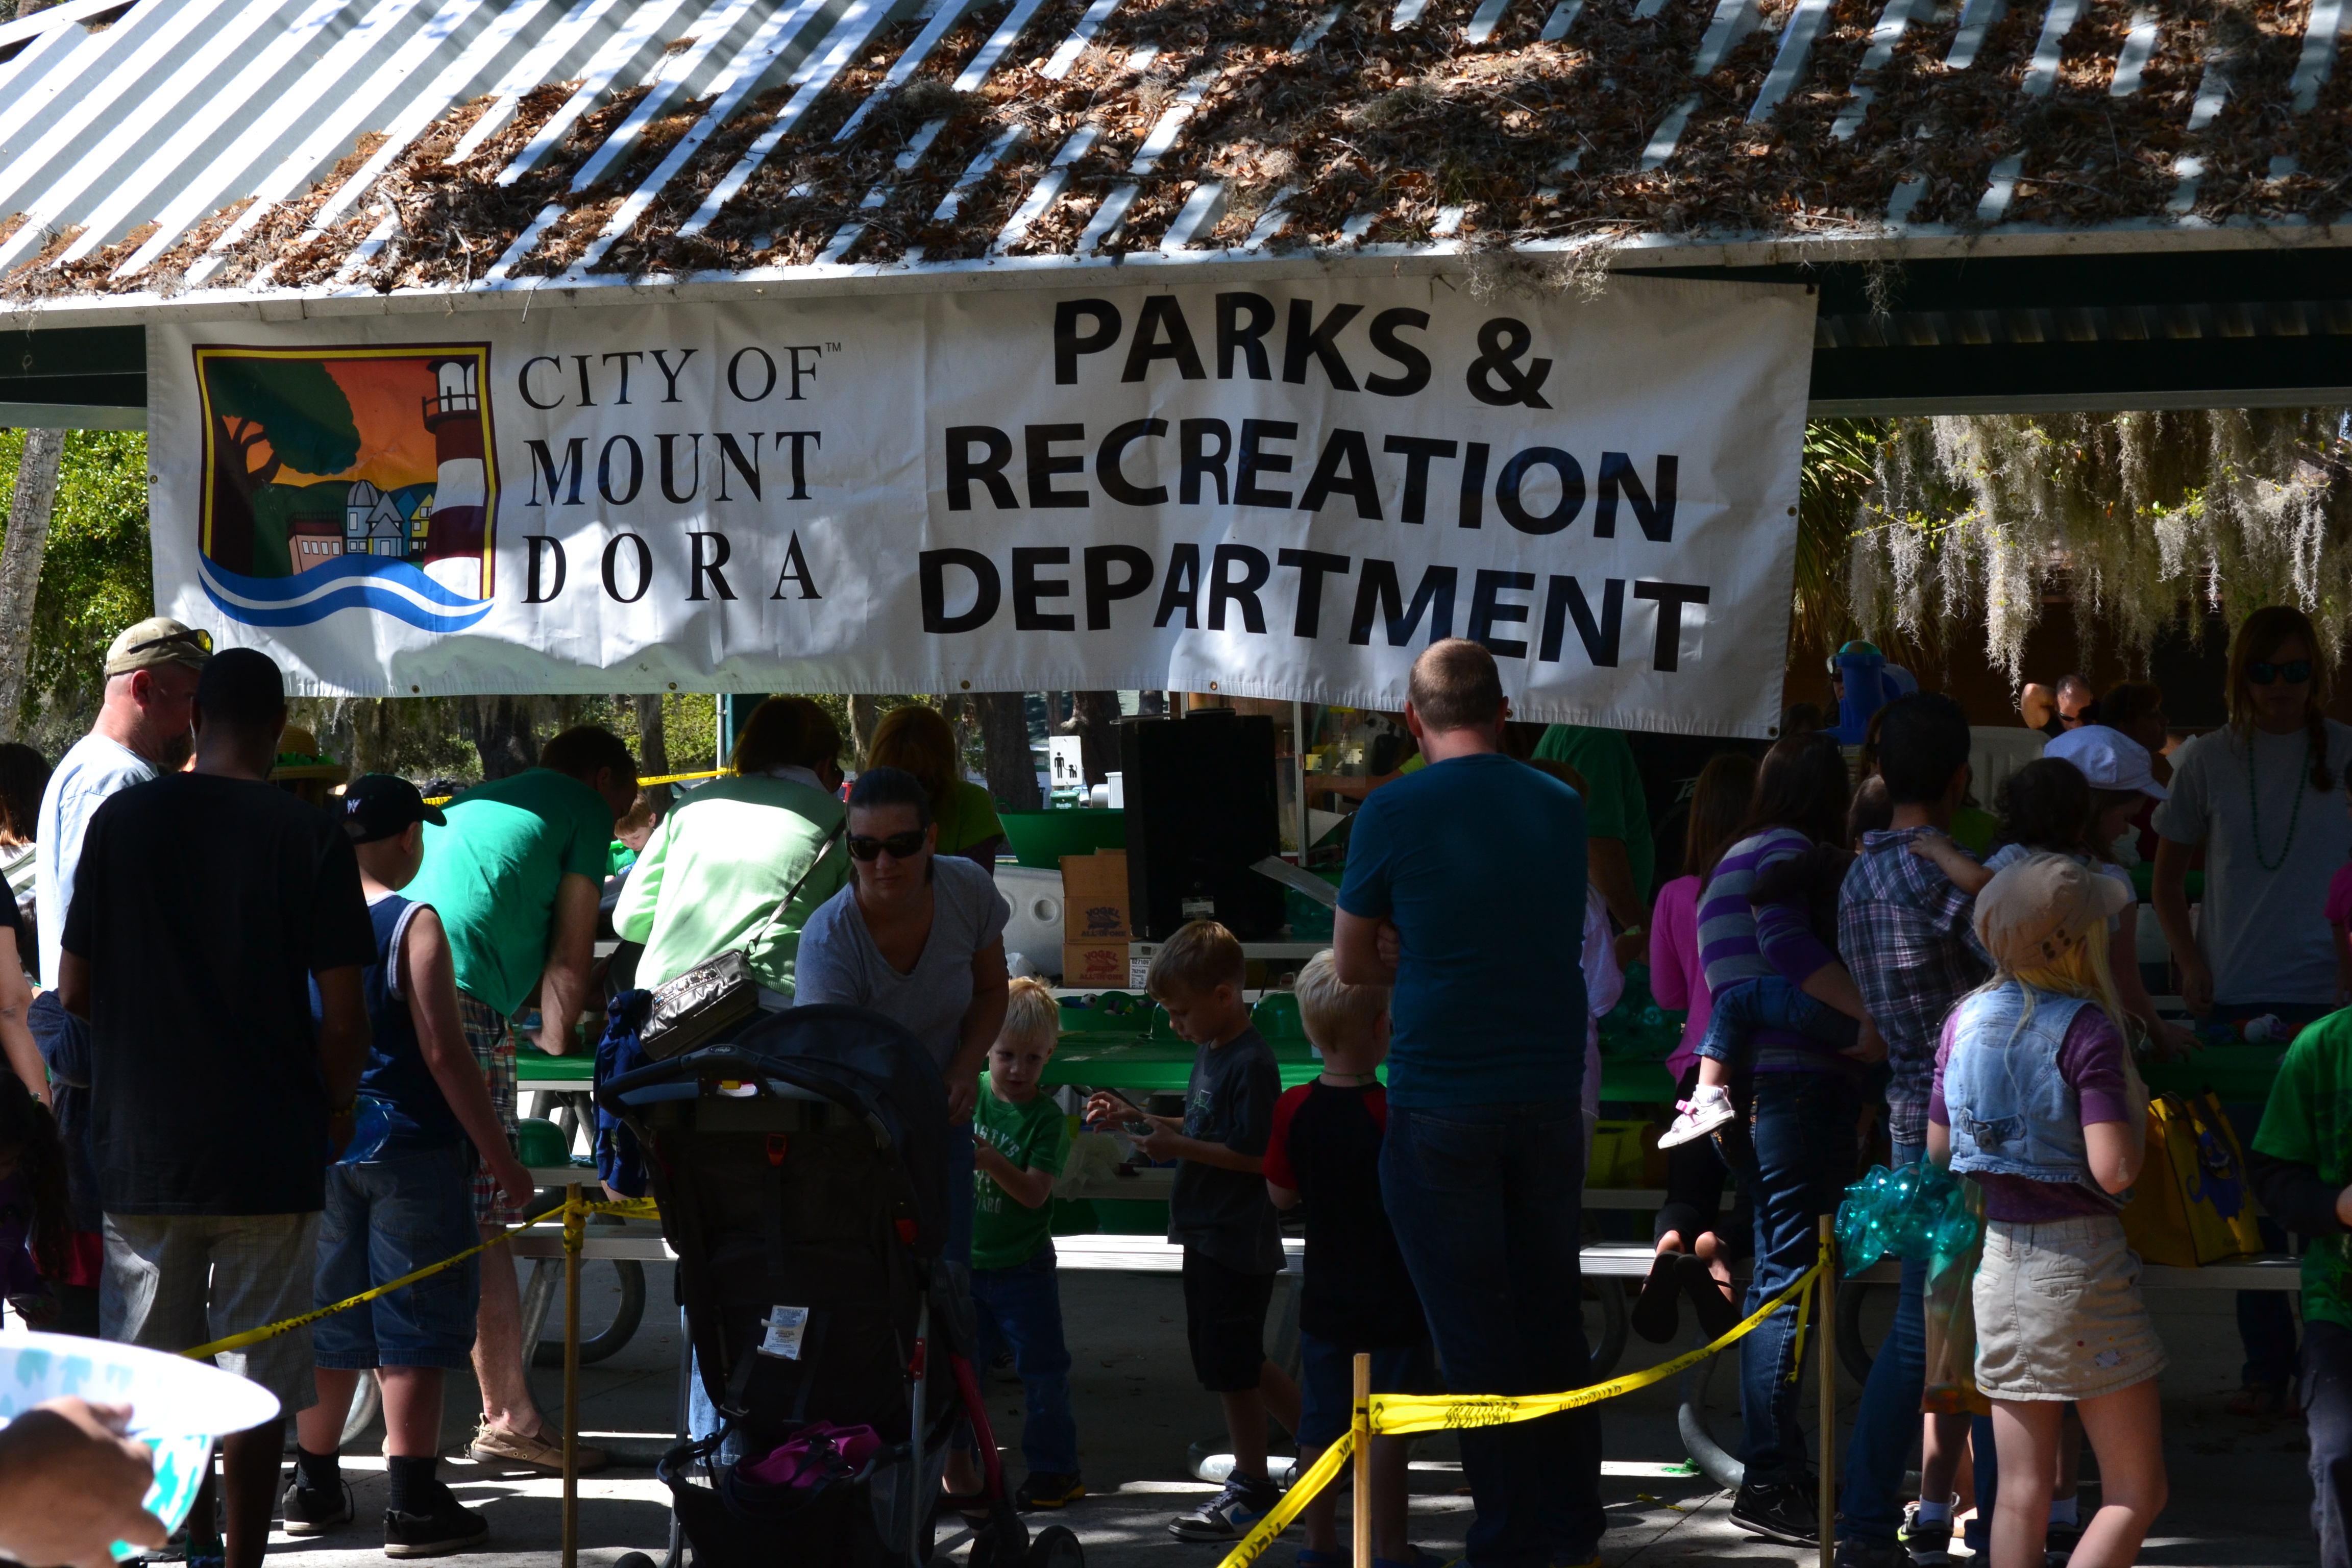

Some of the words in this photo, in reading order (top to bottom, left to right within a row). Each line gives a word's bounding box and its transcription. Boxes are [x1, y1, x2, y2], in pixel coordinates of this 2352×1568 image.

[519, 349, 698, 409] CITY
[728, 346, 821, 402] OF
[1054, 292, 1431, 397] PARKS
[1466, 317, 1553, 409] &
[524, 431, 821, 506] MOUNT
[946, 418, 1678, 542] RECREATION
[521, 529, 822, 603] DORA
[919, 543, 1710, 672] DEPARTMENT
[1086, 906, 1120, 919] VOGEL
[1083, 950, 1118, 962] VOGEL
